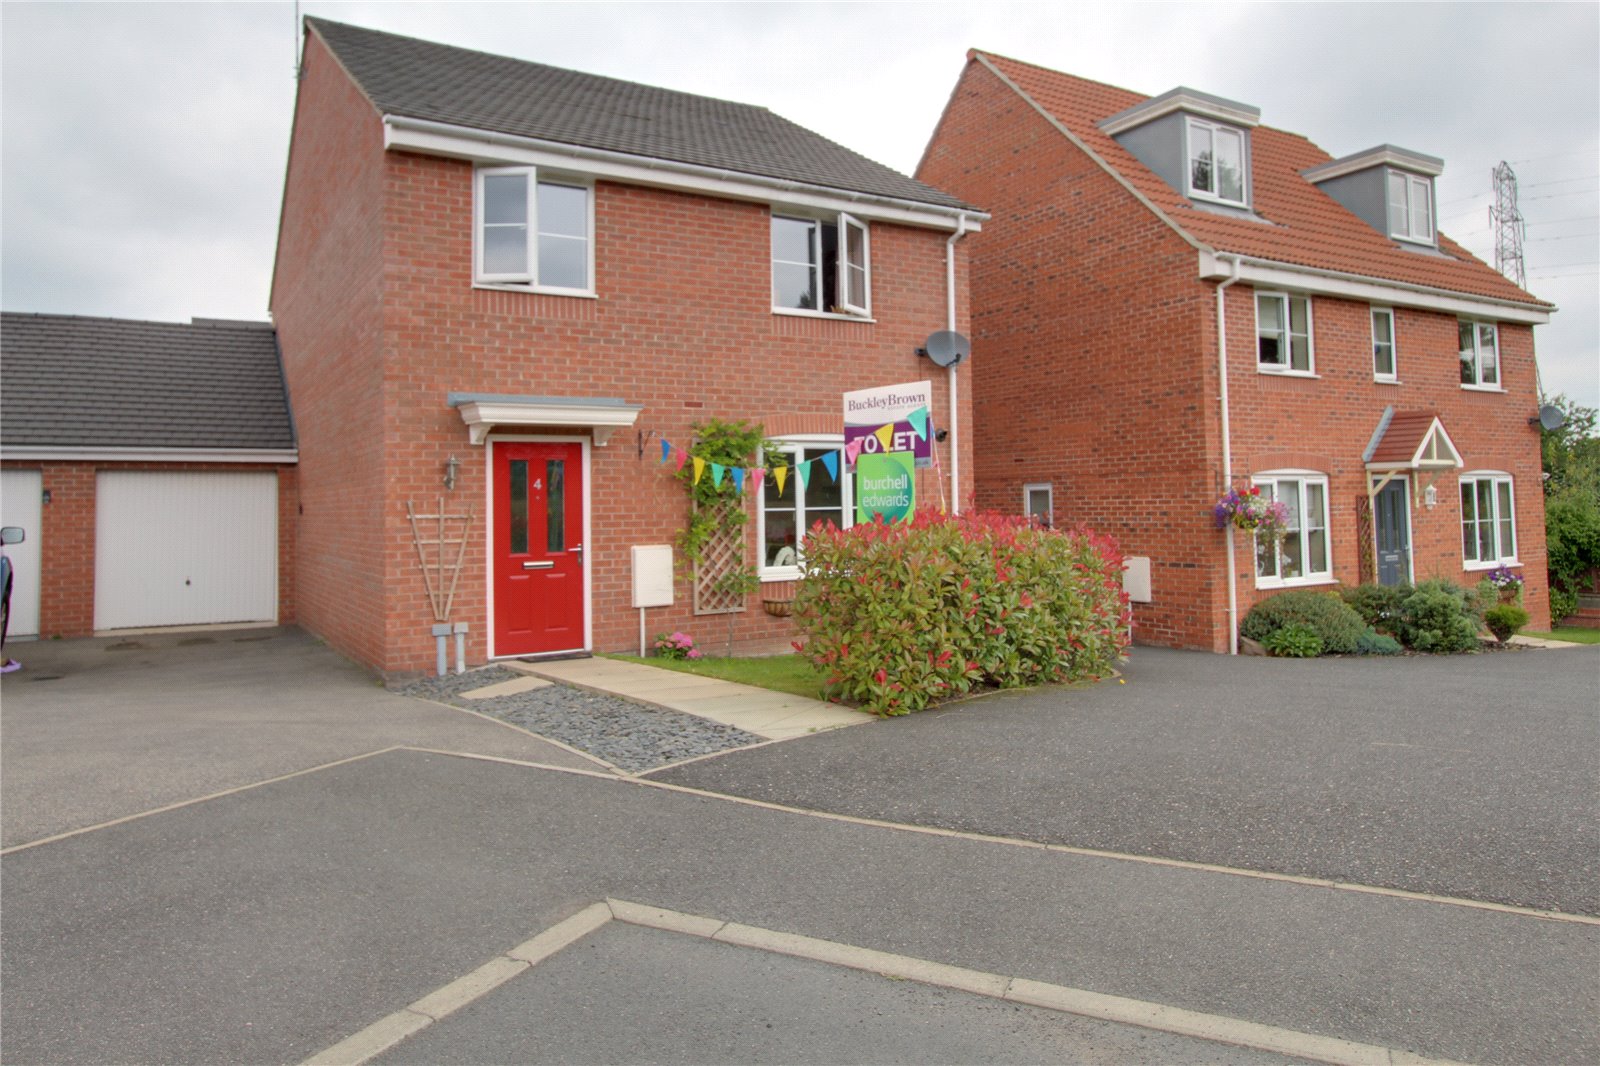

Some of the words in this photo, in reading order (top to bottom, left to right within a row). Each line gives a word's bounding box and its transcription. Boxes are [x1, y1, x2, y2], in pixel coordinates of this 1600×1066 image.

[848, 394, 925, 411] BuckleyBrown
[883, 431, 918, 452] ET
[533, 478, 543, 490] 4
[864, 474, 907, 490] burchell
[863, 491, 909, 507] edwards
